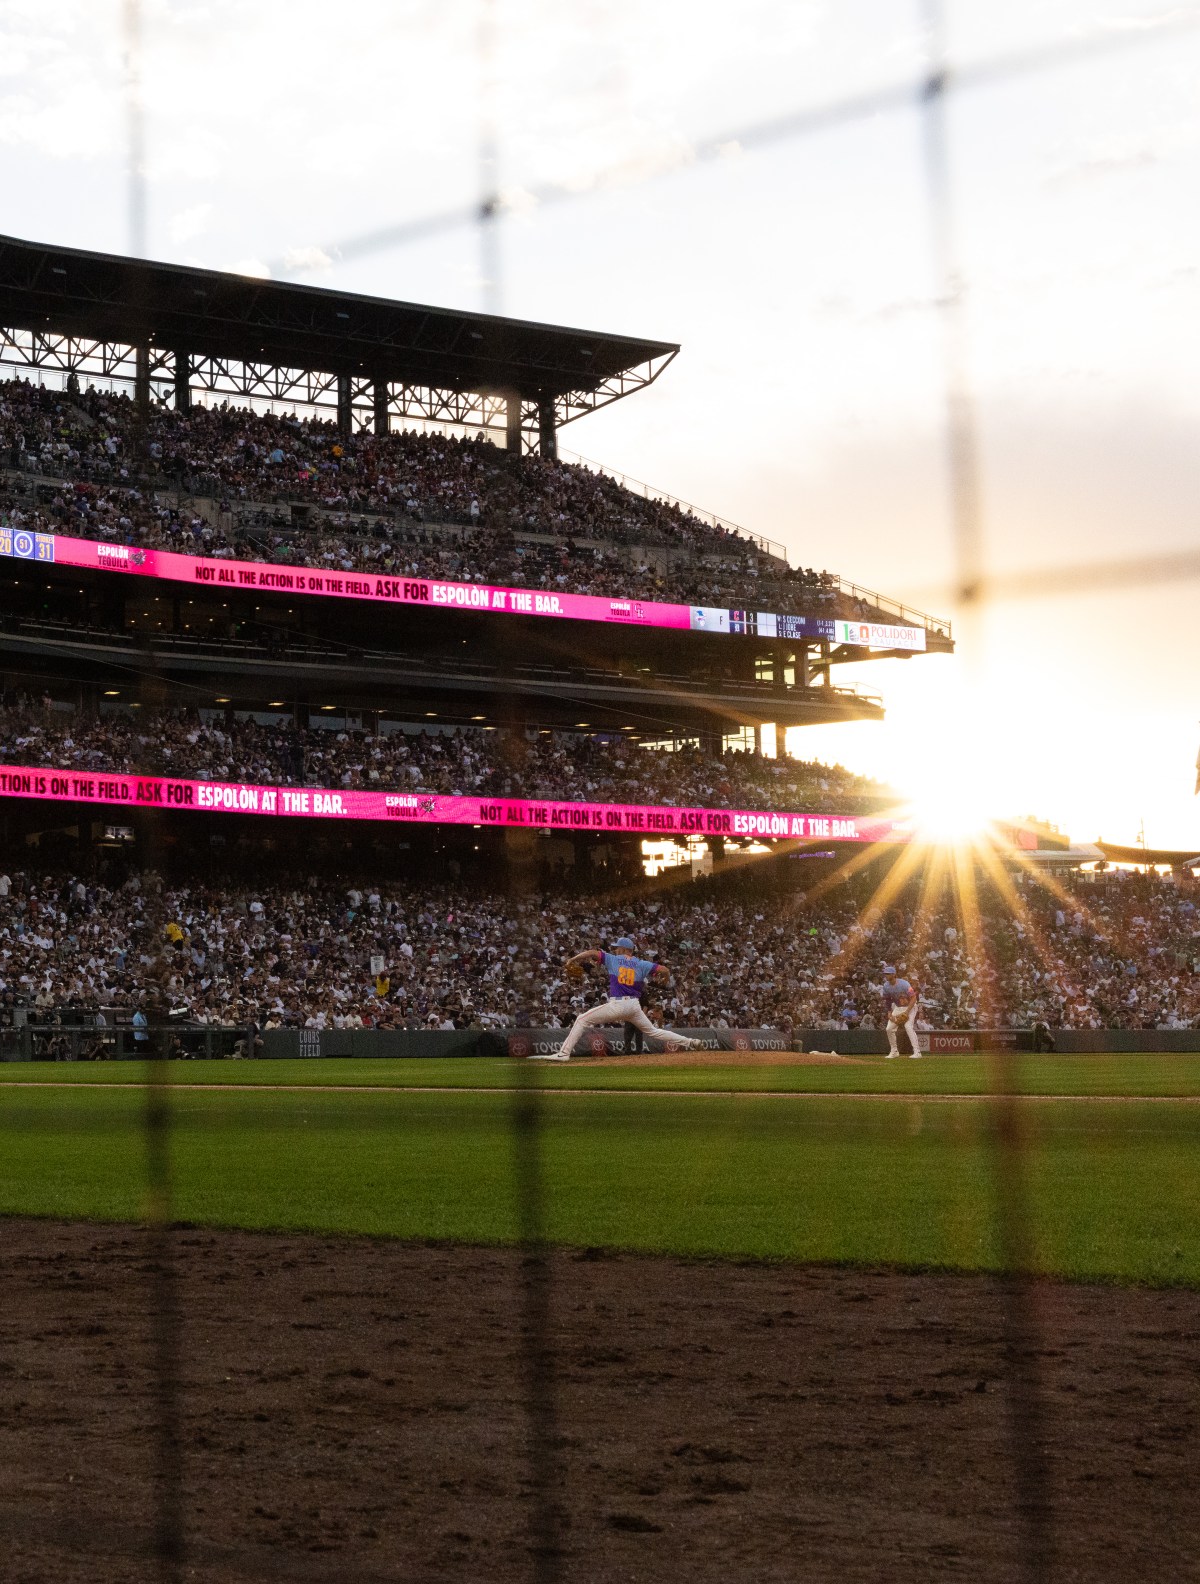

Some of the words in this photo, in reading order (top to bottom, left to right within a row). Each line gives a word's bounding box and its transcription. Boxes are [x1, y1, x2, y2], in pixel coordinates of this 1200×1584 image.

[20, 539, 28, 549] 51
[39, 543, 51, 559] 31
[98, 556, 129, 568] TEQUILA
[196, 566, 215, 580] NOT
[218, 568, 236, 583] ALL
[238, 570, 256, 584] THE
[259, 573, 293, 588] ACTION
[296, 576, 305, 589] IS
[309, 577, 323, 591] ON
[326, 579, 343, 592] THE
[346, 581, 373, 596] FIELD.
[376, 579, 400, 598] ASK
[404, 583, 429, 601] FOR
[433, 585, 489, 607] ESPOLÒN
[492, 591, 506, 609] AT
[509, 593, 532, 611] THE
[535, 595, 564, 614] BAR.
[749, 613, 754, 622] 3
[872, 626, 917, 640] POLIDORI
[875, 639, 914, 647] SAUSAGE
[34, 777, 47, 794] IS
[51, 778, 69, 796] ON
[73, 779, 94, 798] THE
[98, 782, 133, 801] FIELD.
[136, 781, 162, 803] ASK
[167, 784, 193, 805] FOR
[198, 785, 258, 810] ESPOLÒN
[262, 792, 277, 811] AT
[283, 792, 309, 812] THE
[313, 794, 348, 814] BAR.
[386, 806, 418, 818] TEQUILA
[480, 804, 502, 821] NOT
[507, 806, 524, 822] ALL
[528, 807, 548, 824] THE
[551, 808, 589, 826] ACTION
[592, 810, 602, 826] IS
[607, 811, 622, 827] ON
[625, 812, 644, 828] THE
[647, 812, 677, 830] FIELD.
[680, 812, 702, 831] ASK
[707, 814, 731, 832] FOR
[734, 813, 788, 834] ESPOLÒN
[791, 817, 804, 835] AT
[808, 818, 830, 836] THE
[832, 819, 859, 838] BAR.
[300, 1031, 320, 1044] COORS
[934, 1037, 970, 1047] TOYOTA
[300, 1044, 320, 1057] FIELD
[532, 1041, 575, 1054] TOYO
[752, 1039, 786, 1050] TOYOTA
